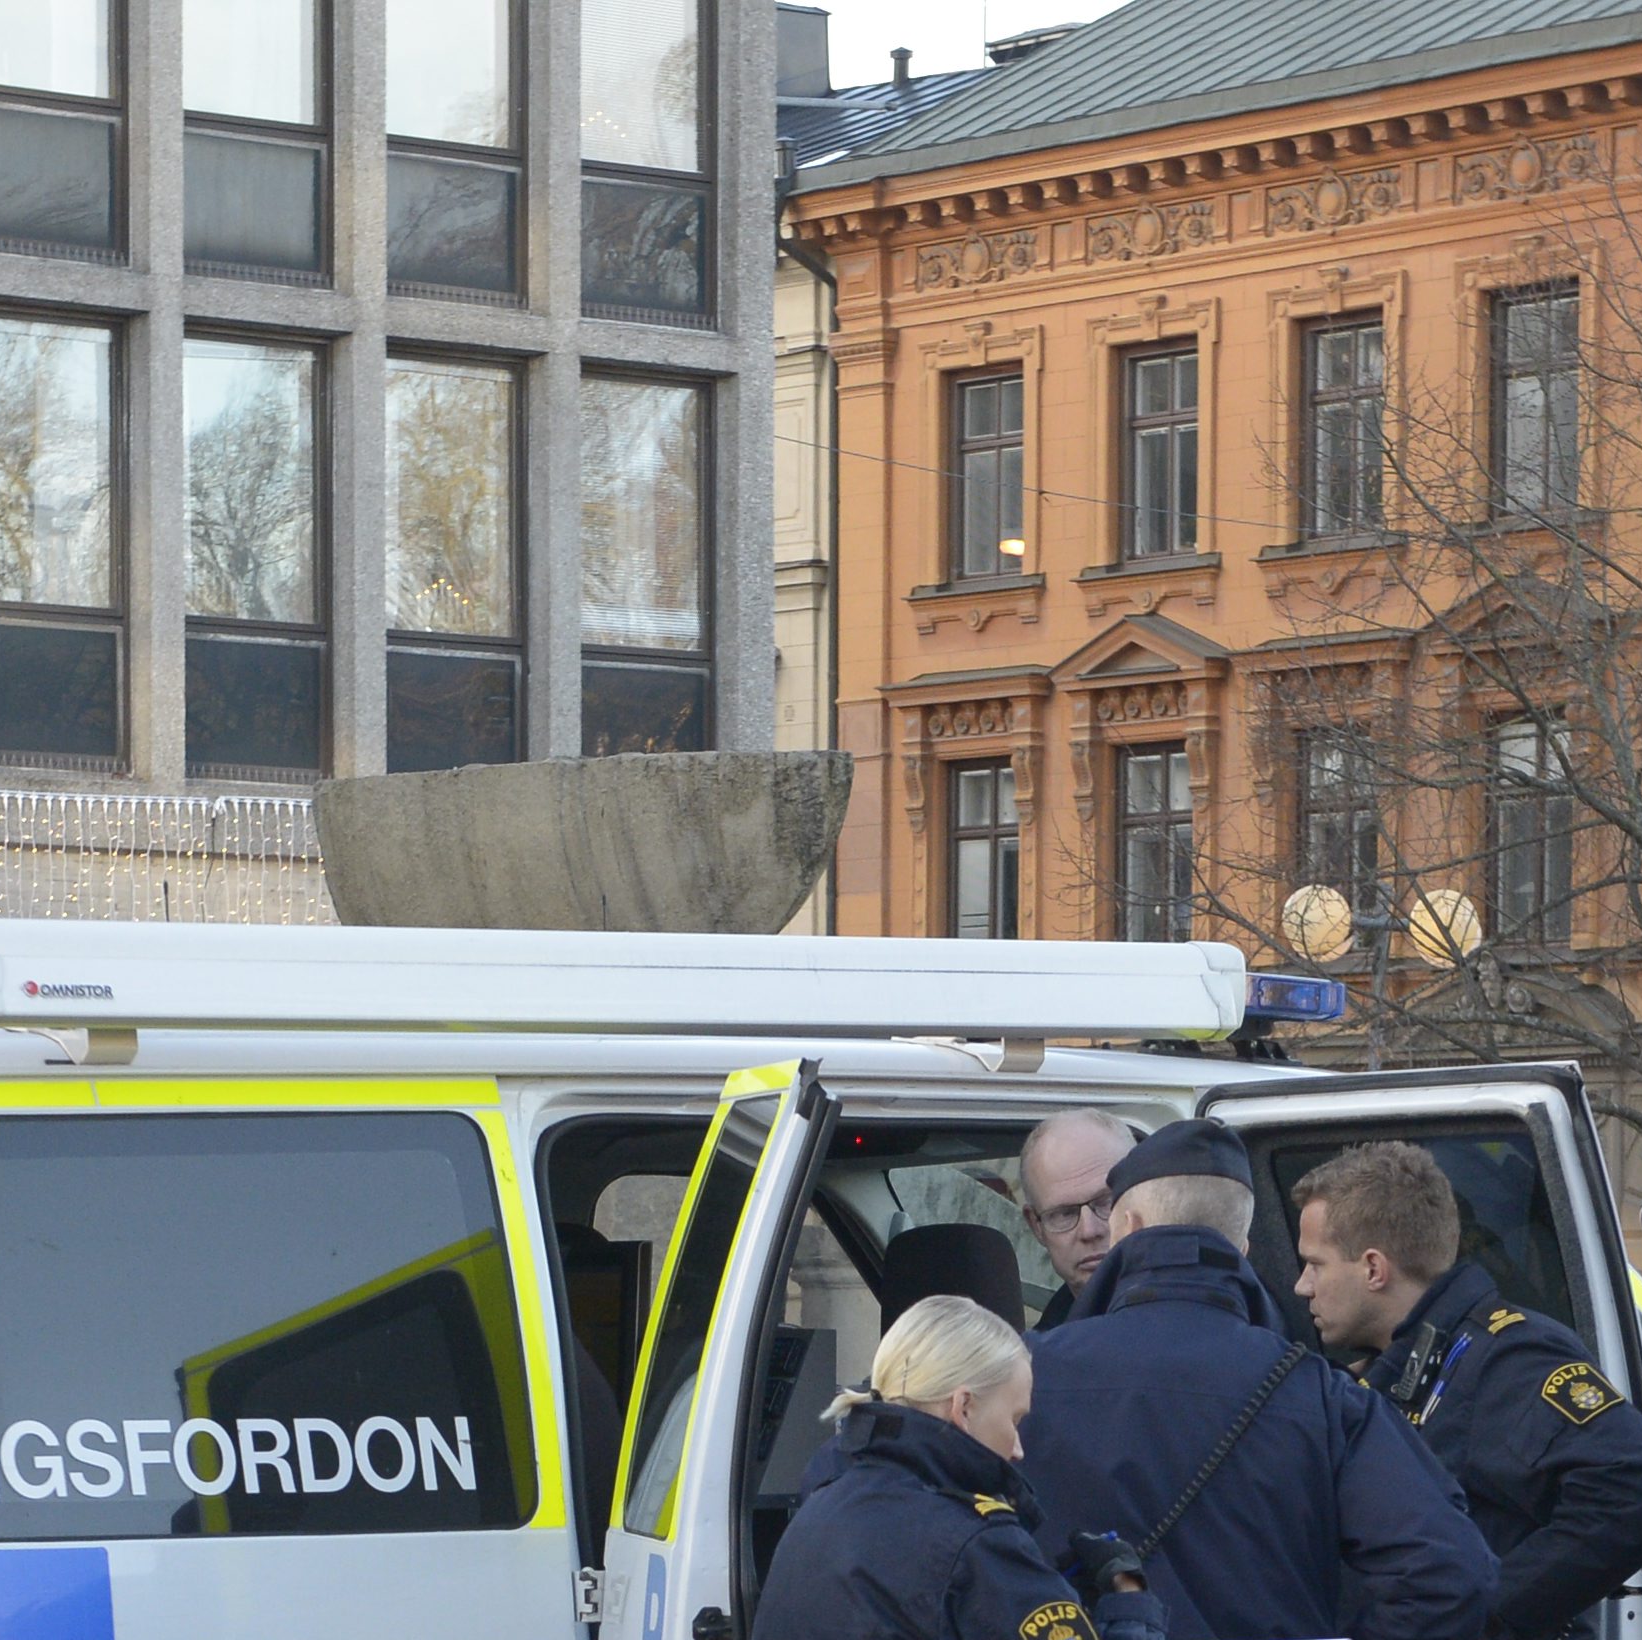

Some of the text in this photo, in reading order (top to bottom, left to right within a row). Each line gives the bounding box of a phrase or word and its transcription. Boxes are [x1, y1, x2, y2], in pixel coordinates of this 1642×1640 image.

[40, 984, 114, 999] OMNISTOR
[1547, 1365, 1589, 1395] POLIS
[1024, 1605, 1078, 1637] POLIS
